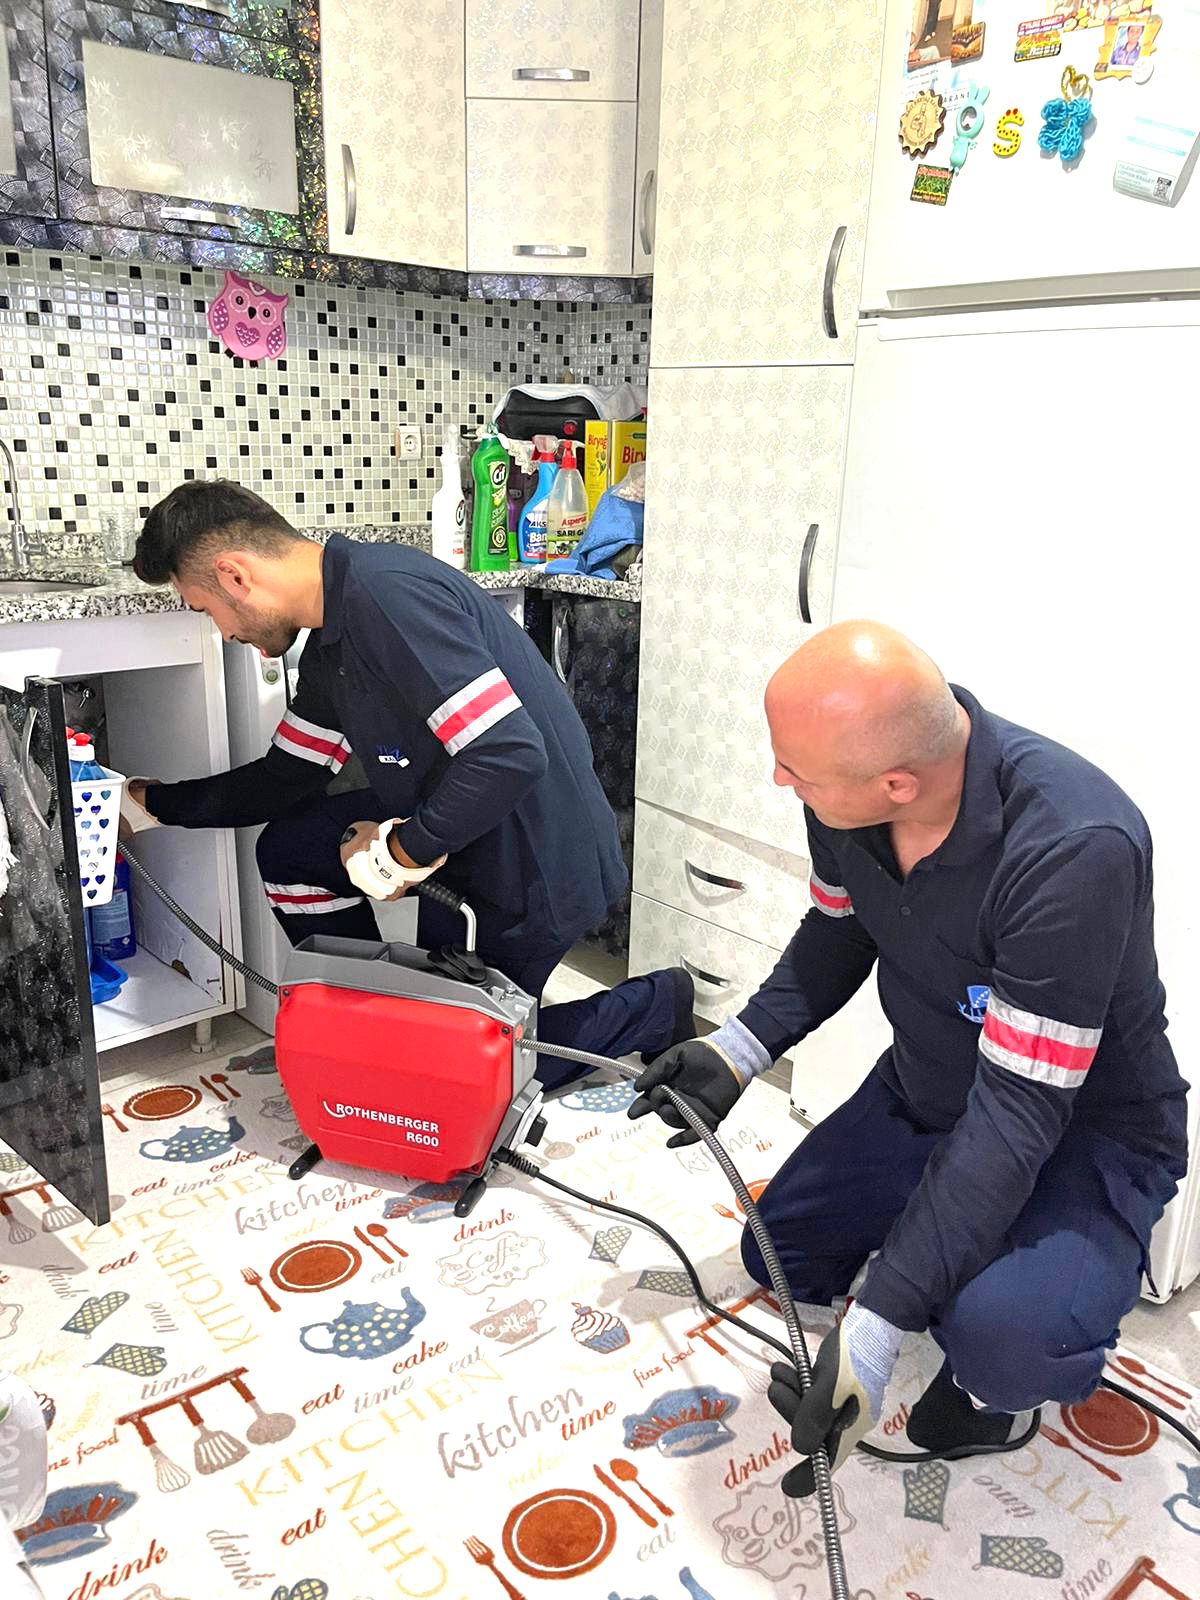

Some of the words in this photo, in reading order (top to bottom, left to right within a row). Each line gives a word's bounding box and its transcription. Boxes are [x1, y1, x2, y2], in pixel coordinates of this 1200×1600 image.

[328, 1102, 440, 1134] ROTHENBERGER
[406, 1131, 440, 1148] R600
[575, 1126, 602, 1145] eat
[209, 1150, 258, 1173] cake
[130, 1177, 168, 1197] eat
[173, 1173, 226, 1197] time
[335, 1188, 384, 1213] time
[235, 1181, 358, 1235] kitchen
[453, 1208, 516, 1242] drink
[97, 1251, 139, 1275] eat
[371, 1262, 406, 1284] eat
[391, 1340, 449, 1375] cake
[449, 1345, 486, 1375] eat
[141, 1364, 207, 1401] time
[354, 1375, 414, 1414] time
[300, 1383, 345, 1416] eat
[437, 1386, 584, 1479] kitchen
[561, 1400, 617, 1441] time
[722, 1431, 793, 1491] drink
[280, 1506, 328, 1547] eat
[636, 1521, 677, 1563] eat
[66, 1538, 169, 1600] drink
